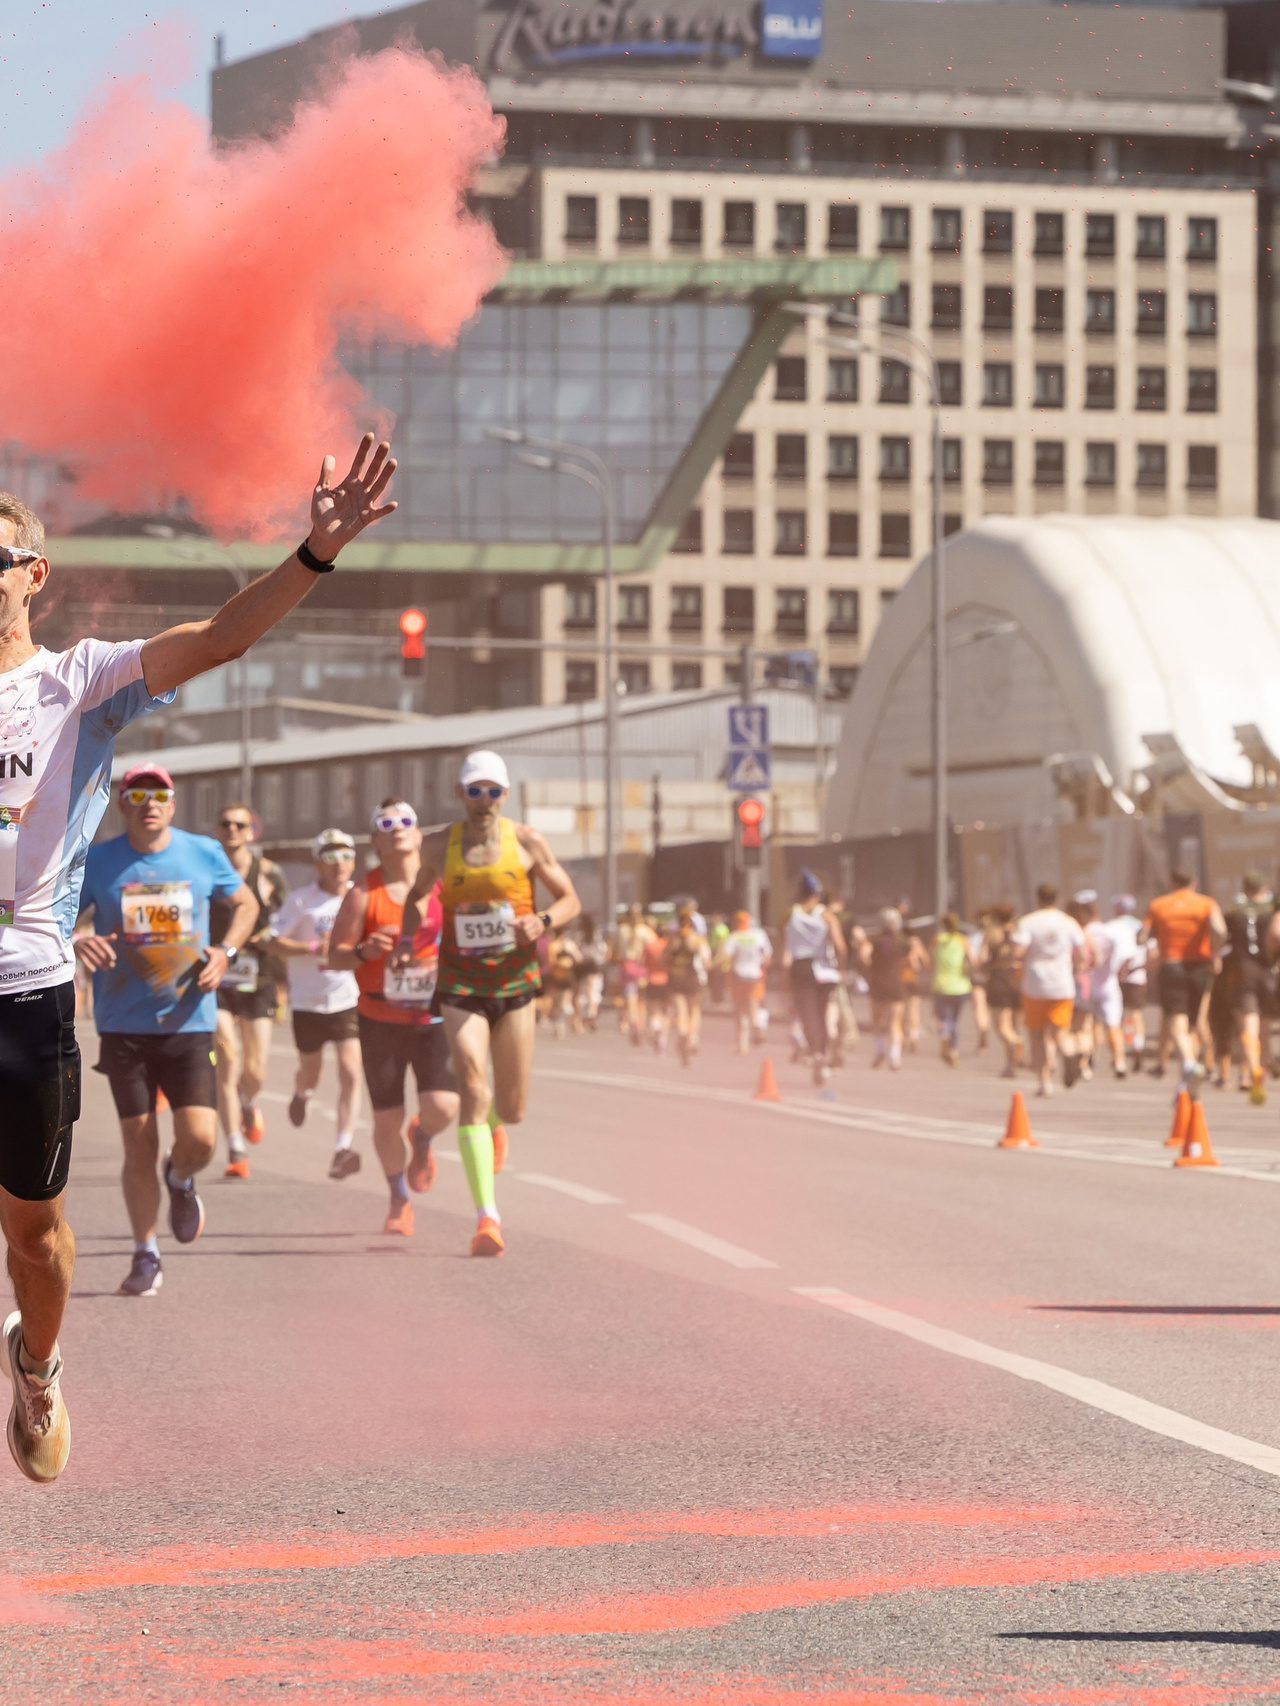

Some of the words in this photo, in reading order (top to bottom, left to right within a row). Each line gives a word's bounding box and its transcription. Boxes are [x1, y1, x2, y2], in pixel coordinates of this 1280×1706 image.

[136, 905, 180, 923] 1768
[464, 920, 506, 939] 5136
[14, 993, 44, 1003] DEMIX
